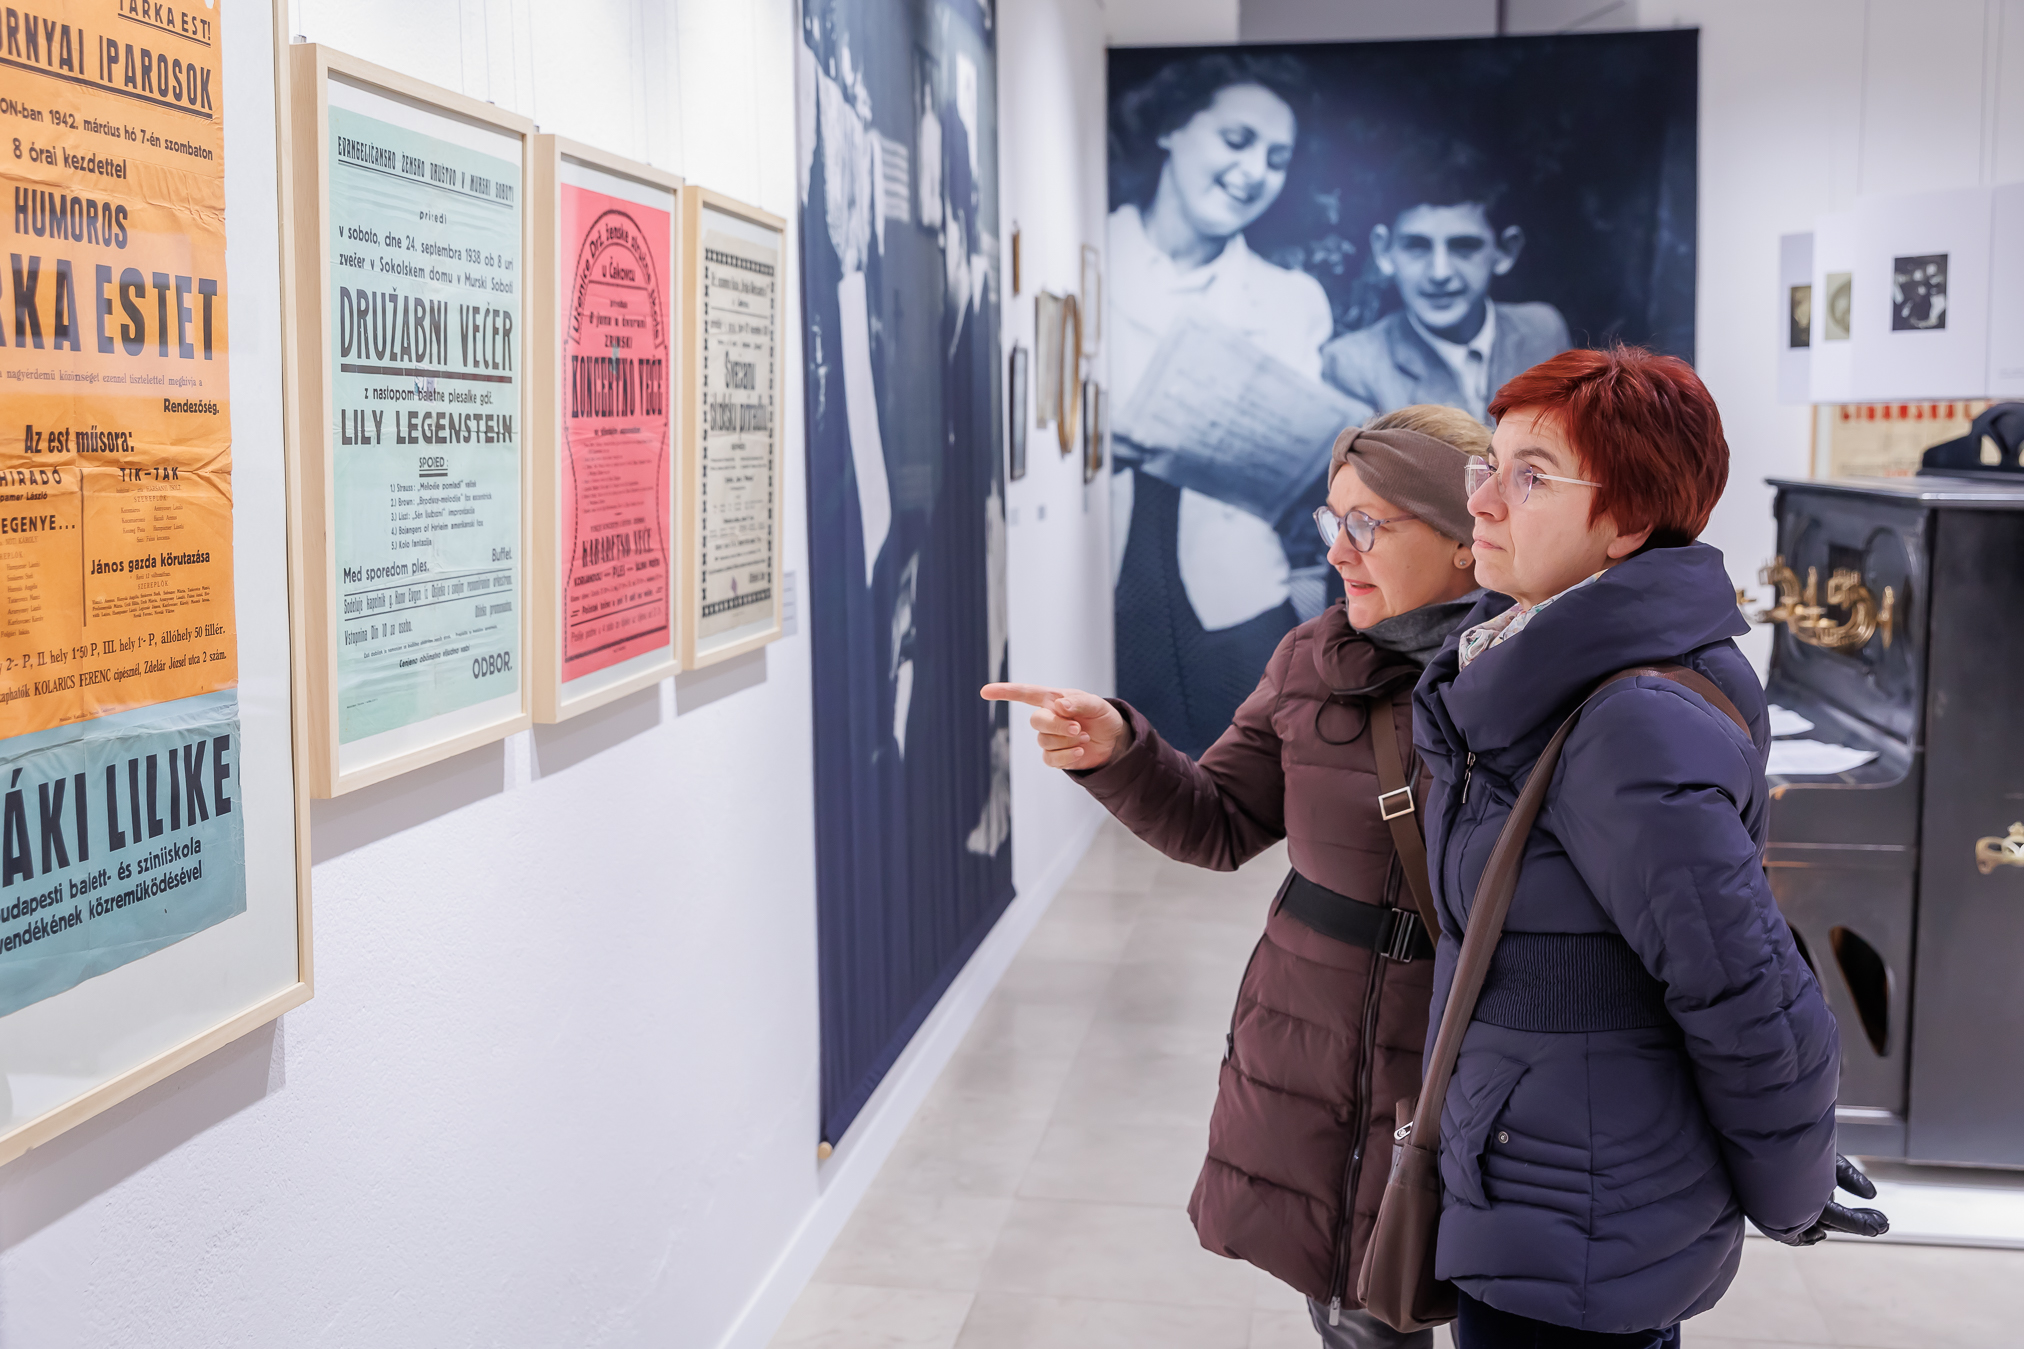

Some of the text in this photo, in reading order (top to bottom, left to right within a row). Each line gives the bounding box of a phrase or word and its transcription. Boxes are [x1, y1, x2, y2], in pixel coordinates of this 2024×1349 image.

[181, 11, 211, 41] EST!
[0, 5, 213, 112] RNYAI IPAROSOK
[49, 109, 79, 131] 1942.
[83, 118, 121, 139] március
[124, 124, 137, 142] hó
[140, 129, 161, 149] 7-én
[164, 138, 213, 161] szombaton
[12, 137, 127, 180] 8 órai kezdettel
[14, 185, 128, 250] HUMOROS
[338, 225, 344, 239] v
[347, 224, 381, 248] soboto,
[384, 231, 402, 249] dne
[405, 235, 418, 252] 24.
[420, 241, 462, 261] septembra
[465, 247, 482, 265] 1938
[484, 252, 495, 268] ob
[497, 254, 503, 269] 8
[339, 252, 514, 294] zvečer v Sokolskem domu v Murski Soboti
[0, 252, 218, 361] KA ESTET
[339, 285, 513, 372] DRUŽABNI VEČER
[59, 370, 100, 384] közönséget
[102, 374, 127, 384] ezennel
[129, 372, 165, 386] tisztelettel
[364, 387, 369, 400] z
[372, 385, 415, 403] nastopom
[448, 389, 477, 404] plesalke
[571, 355, 636, 418] KONCERTNO
[163, 397, 220, 415] Rendezőség.
[341, 408, 513, 446] LILY LEGENSTEIN
[24, 424, 135, 454] Az est műsora:
[26, 491, 48, 501] László
[90, 549, 210, 575] János gazda körutazása
[343, 558, 430, 585] Med sporedom ples.
[49, 648, 68, 665] hely
[102, 639, 117, 655] III.
[119, 637, 136, 652] hely
[160, 627, 193, 645] állóhely
[194, 625, 203, 639] 50
[204, 622, 226, 637] fillér.
[472, 650, 513, 680] ODBOR.
[0, 648, 227, 705] aphatók KOLARICS FERENC cipésznél, Zdelár József utca 2 szám.
[2, 733, 232, 889] ÁKI LILIKE
[0, 836, 202, 924] udapesti balett- és sziniiskola
